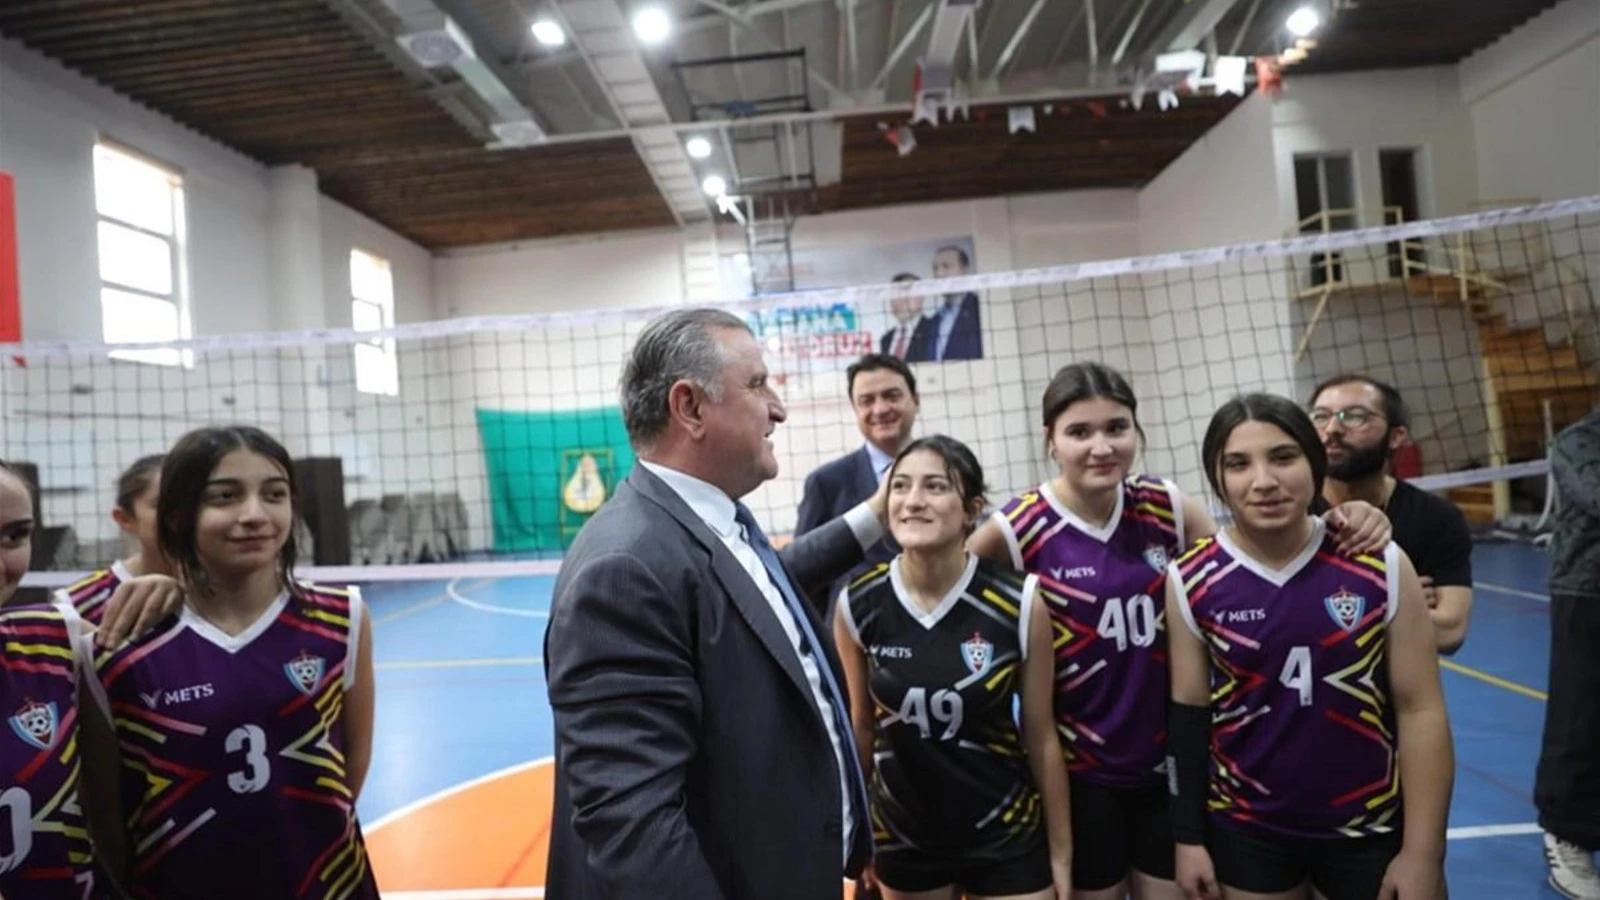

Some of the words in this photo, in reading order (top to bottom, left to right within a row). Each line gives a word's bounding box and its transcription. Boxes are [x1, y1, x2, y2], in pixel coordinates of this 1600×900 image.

[1065, 566, 1096, 579] METS
[1096, 593, 1156, 652] 40
[1228, 608, 1266, 622] METS
[880, 646, 912, 659] METS
[164, 683, 214, 705] METS
[1279, 646, 1313, 706] 4
[898, 686, 964, 741] 49
[225, 724, 271, 794] 3
